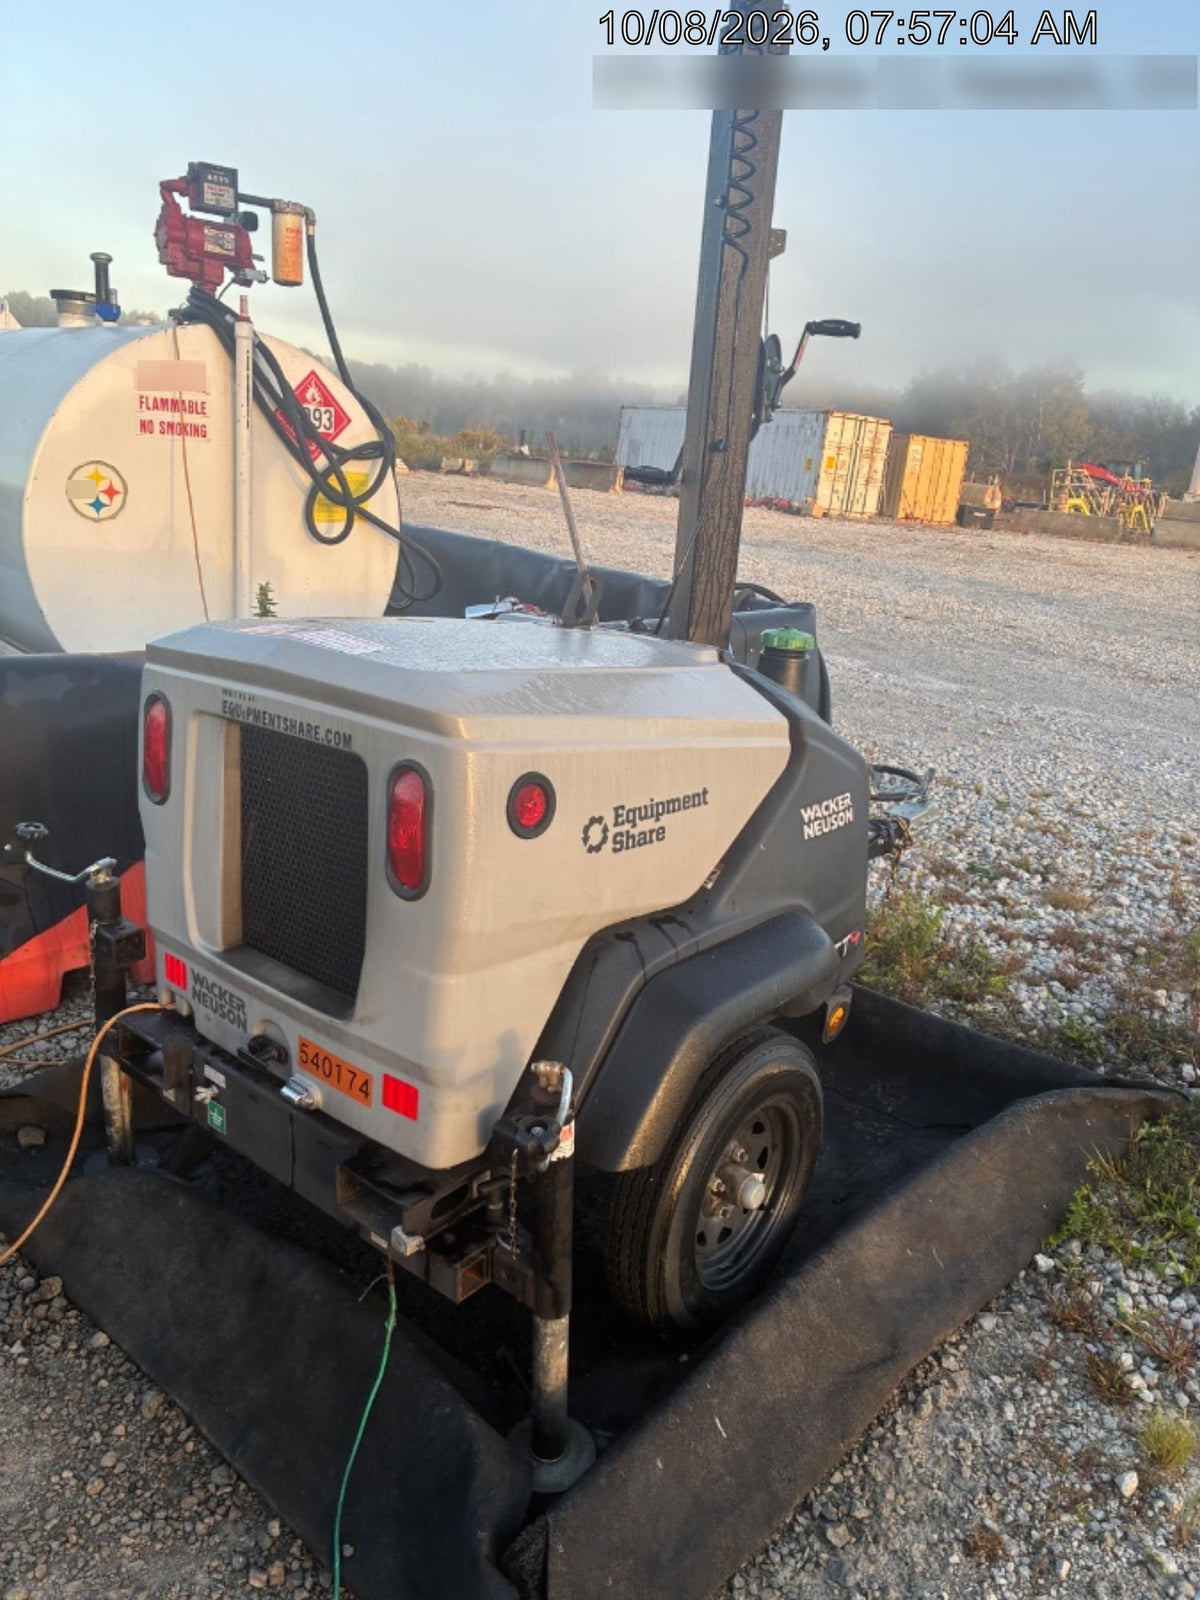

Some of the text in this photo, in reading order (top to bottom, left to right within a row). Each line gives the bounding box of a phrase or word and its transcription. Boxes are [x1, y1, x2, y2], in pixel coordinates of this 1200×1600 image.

[138, 395, 207, 415] FLAMMABLE
[139, 419, 207, 438] NO SMOKING
[613, 787, 709, 828] Equipment
[800, 792, 852, 823] WACKER
[803, 806, 854, 840] NEUSON
[612, 826, 665, 853] Share
[191, 968, 247, 1017] WACKER
[192, 985, 248, 1034] NEUSON
[300, 1043, 370, 1099] 540174
